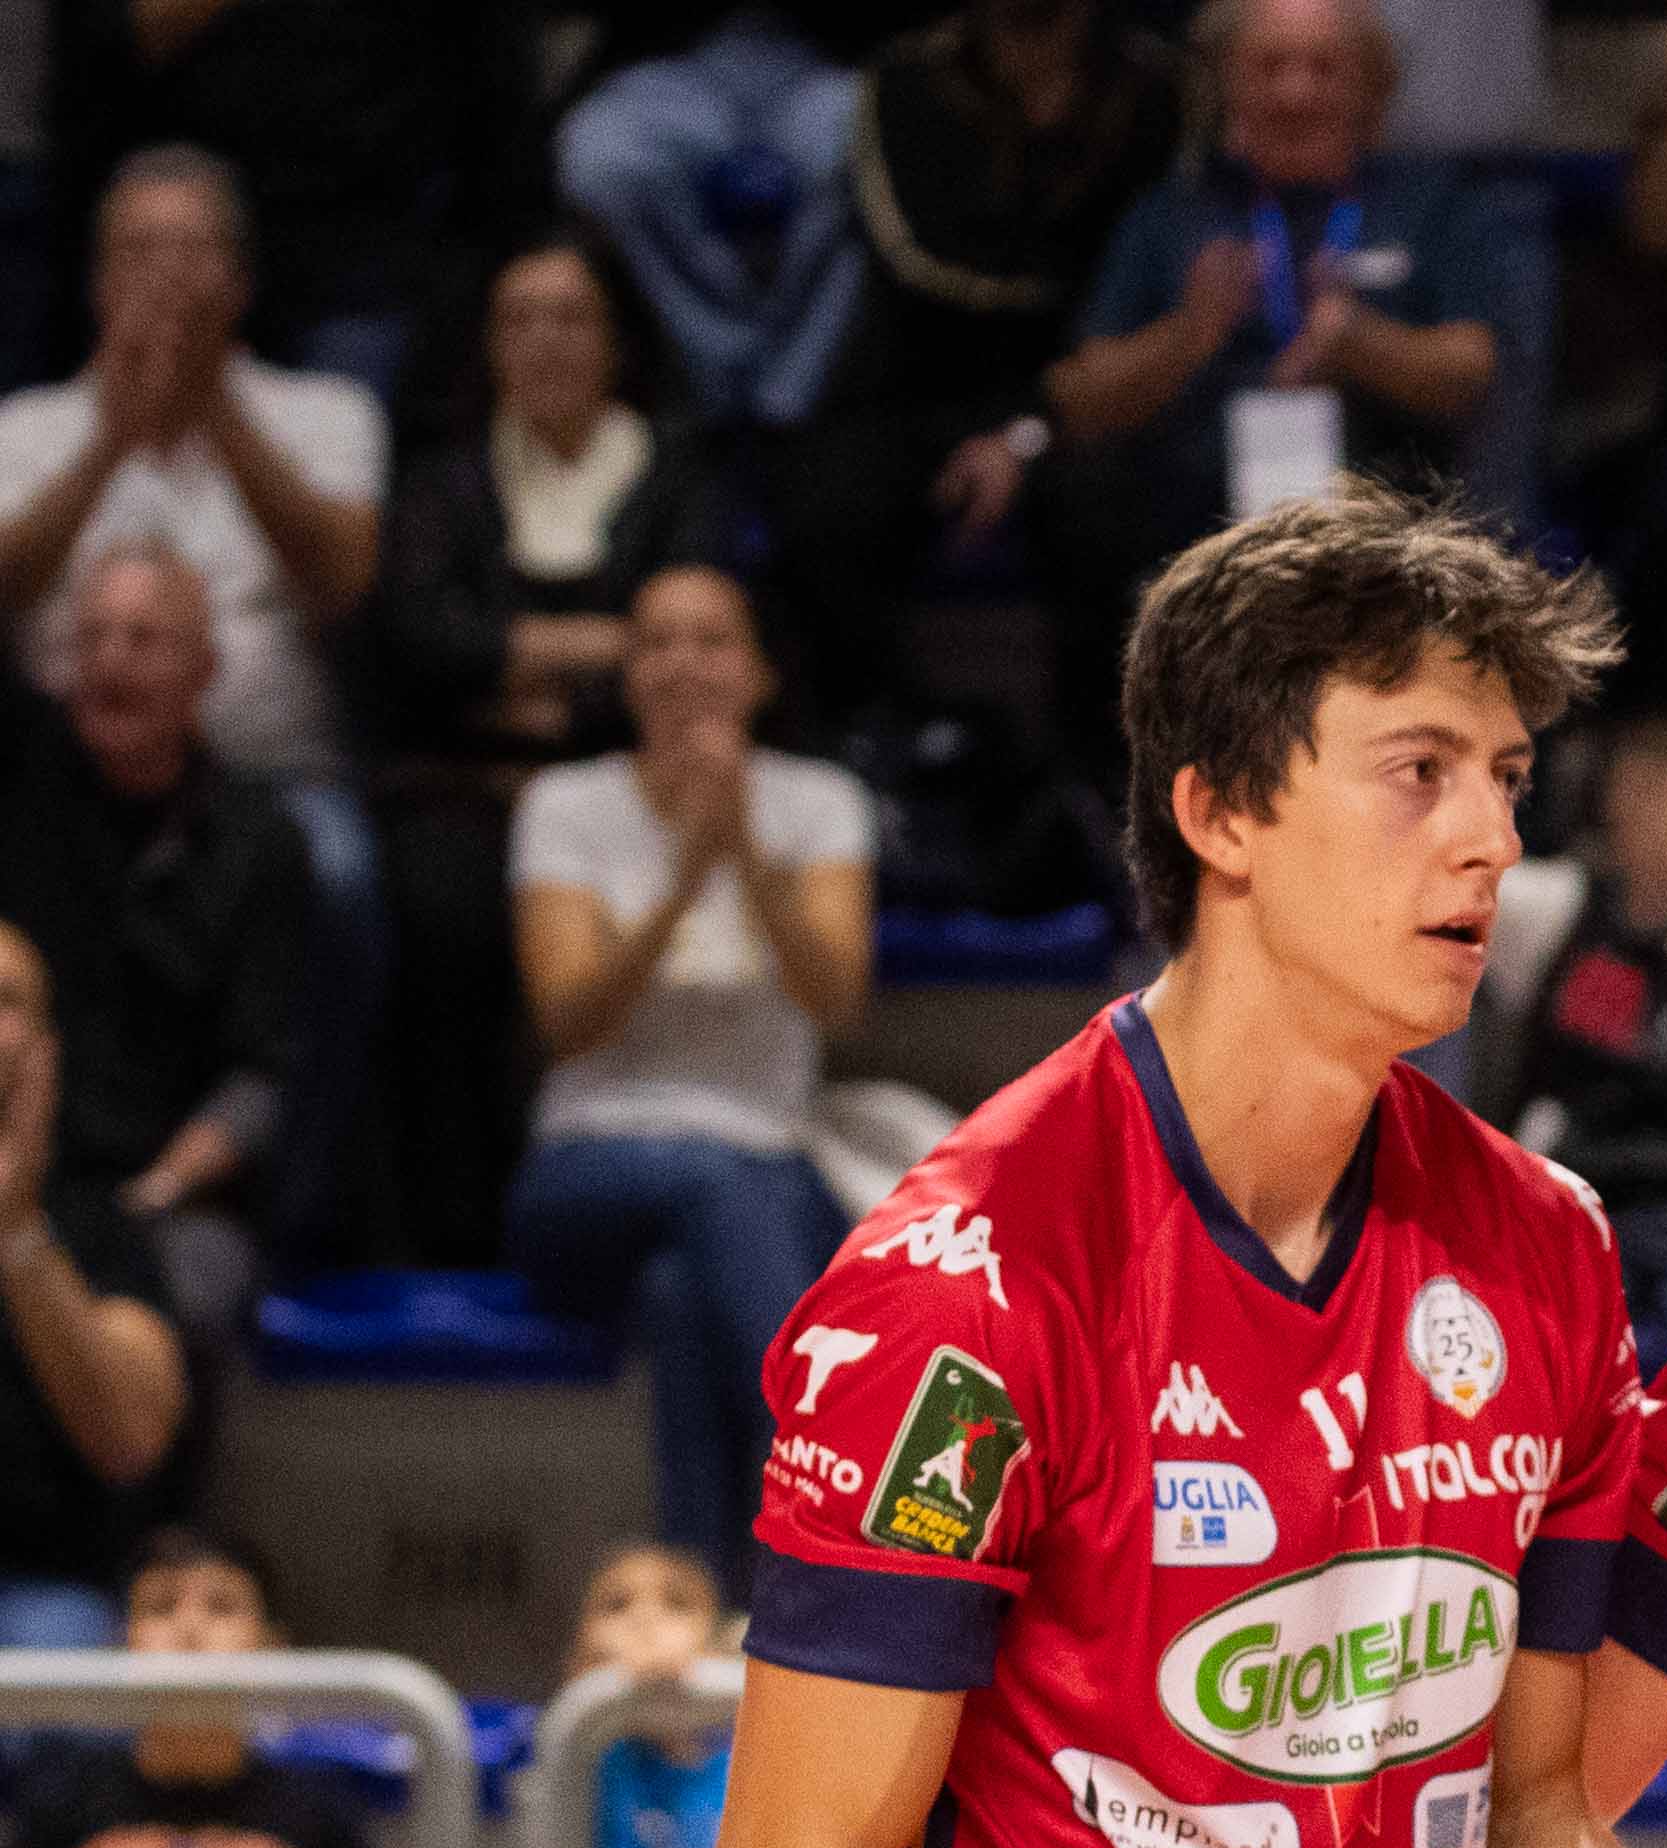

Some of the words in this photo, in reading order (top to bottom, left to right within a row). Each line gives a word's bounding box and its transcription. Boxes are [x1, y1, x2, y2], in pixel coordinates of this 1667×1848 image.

[1195, 1584, 1502, 1737] GIOIELLA
[1286, 1732, 1341, 1758] Gioia
[1347, 1734, 1365, 1751] a
